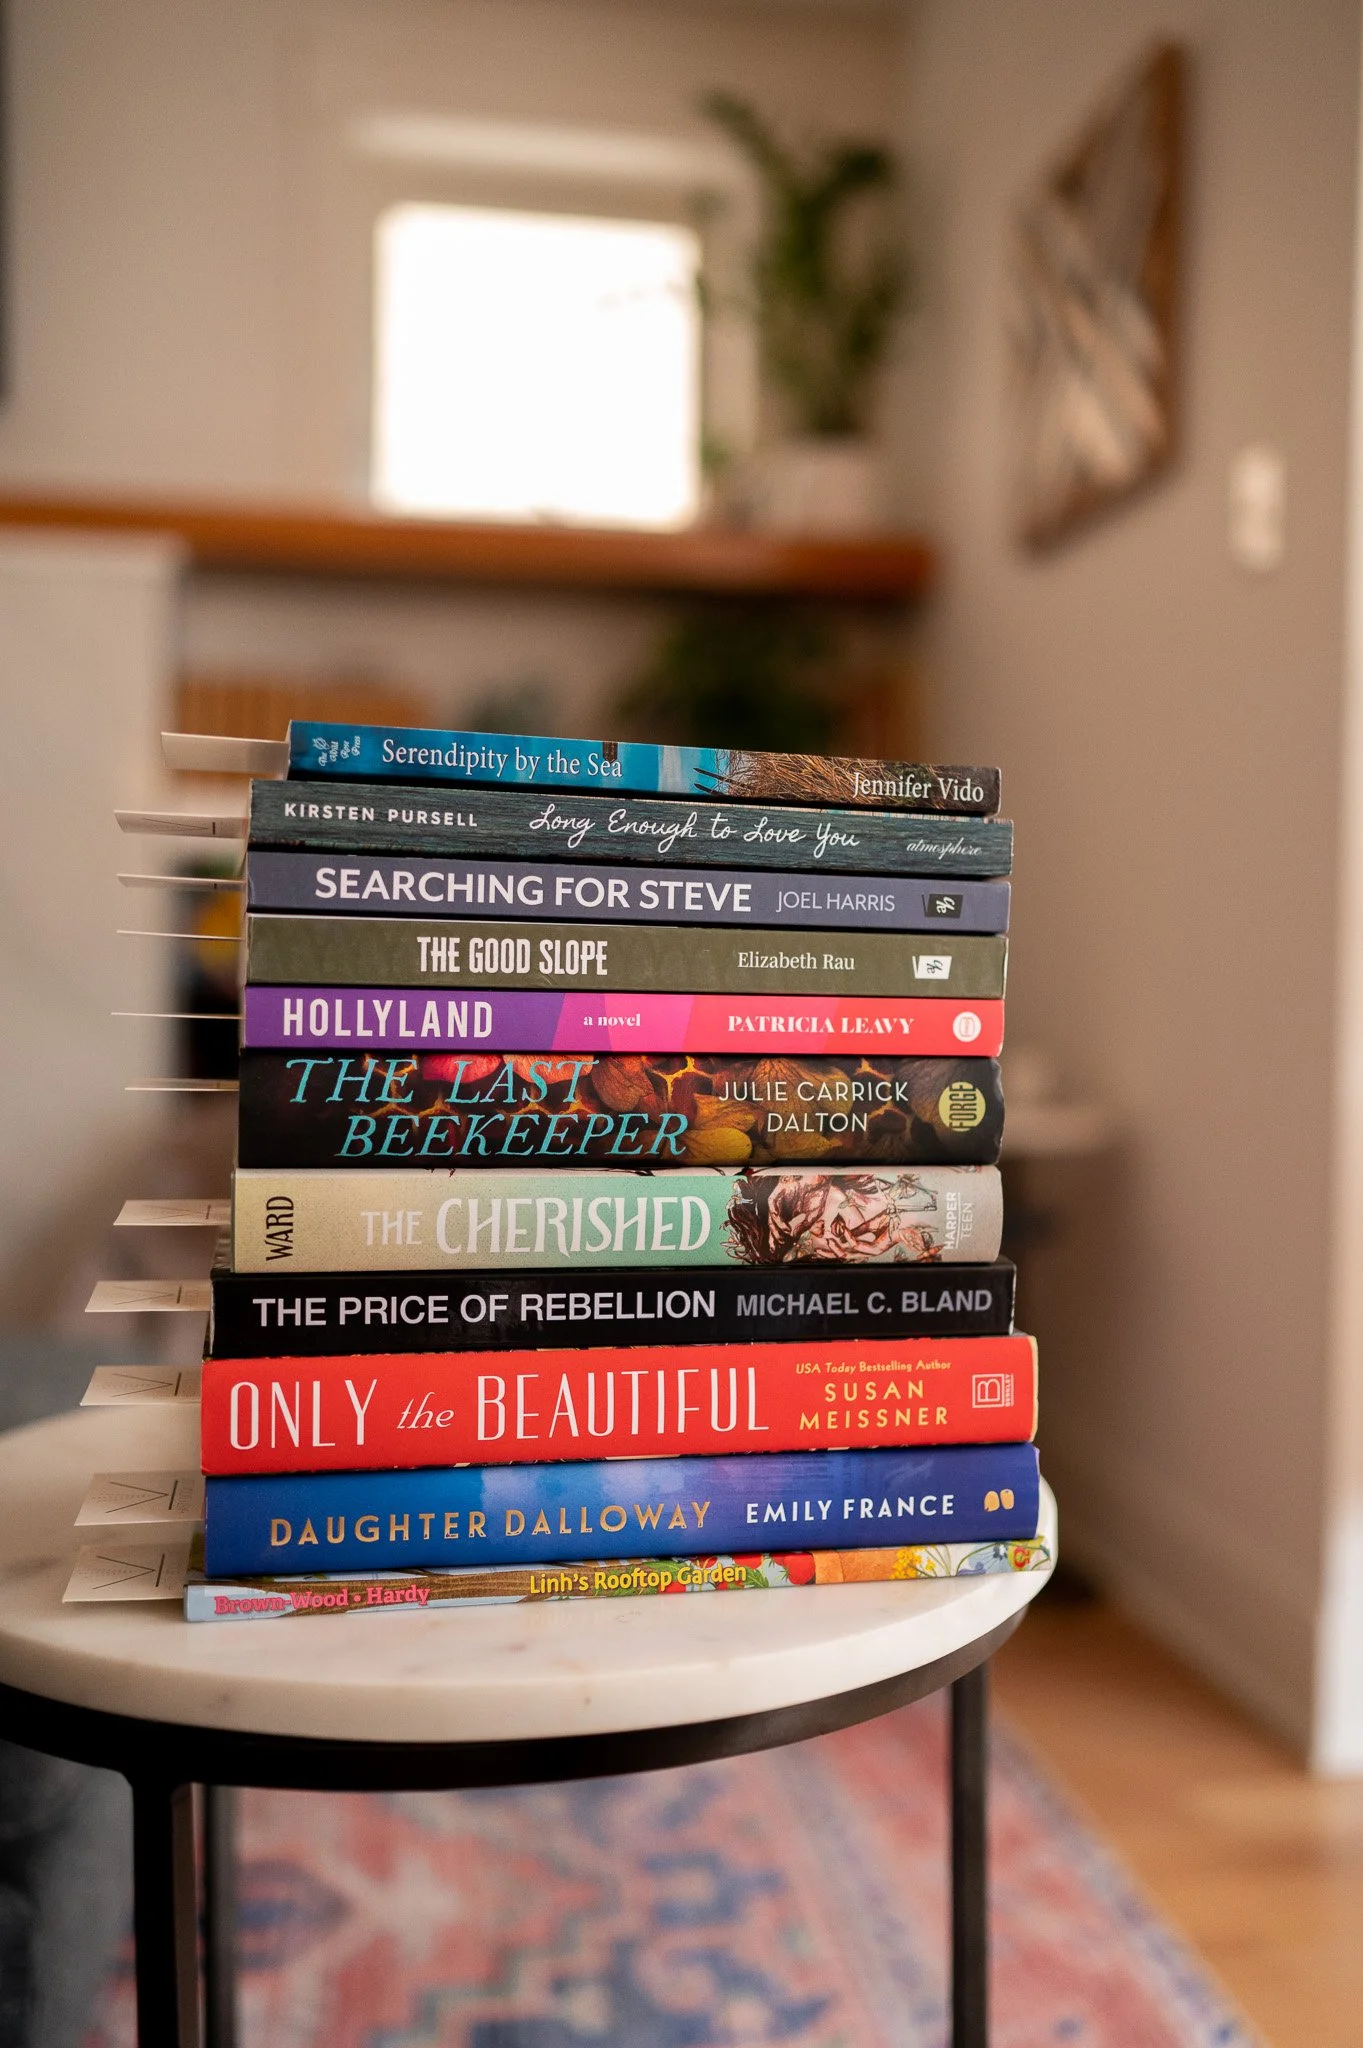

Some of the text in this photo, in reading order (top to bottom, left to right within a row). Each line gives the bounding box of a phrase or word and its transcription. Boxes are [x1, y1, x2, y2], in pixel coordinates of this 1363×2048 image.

[352, 736, 360, 756] Press
[382, 738, 622, 779] Serendipity by the Sea
[852, 771, 985, 803] Jennifer Vido
[284, 803, 478, 827] KIRSTEN PURSELL
[529, 803, 861, 858] Long Enough to Love You
[906, 837, 982, 860] atmosphere
[315, 867, 752, 912] SEARCHING FOR STEVE
[775, 889, 896, 913] JOEL HARRIS
[417, 936, 609, 976] THE GOOD SLOPE
[737, 951, 855, 970] Elizabeth Rau
[283, 998, 493, 1038] HOLLYLAND
[583, 1013, 641, 1027] a novel
[728, 1015, 915, 1035] PATRICIA LEAVY
[285, 1057, 600, 1103] THE LAST
[718, 1081, 909, 1102] JULIE CARRICK
[767, 1112, 868, 1133] DALTON
[949, 1084, 977, 1129] FORGE
[334, 1111, 689, 1157] BEEKEEPER
[265, 1195, 294, 1262] WARD
[361, 1196, 711, 1258] THE CHERISHED
[943, 1192, 957, 1249] HARPER
[961, 1203, 973, 1240] TEEN
[253, 1290, 715, 1327] THE PRICE OF REBELLION
[736, 1289, 992, 1317] MICHAEL C. BLAND
[795, 1358, 951, 1376] USA Today Bestselling Author
[824, 1379, 925, 1402] SUSAN
[229, 1367, 769, 1450] ONLY the BEAUTIFUL
[799, 1406, 949, 1431] MEISSNER
[270, 1501, 711, 1547] DAUGHTER DALLOWAY
[746, 1494, 955, 1524] EMILY FRANCE
[530, 1563, 747, 1595] Linh's Rooftop Garden
[214, 1584, 431, 1615] Brown-Wood Hardy
